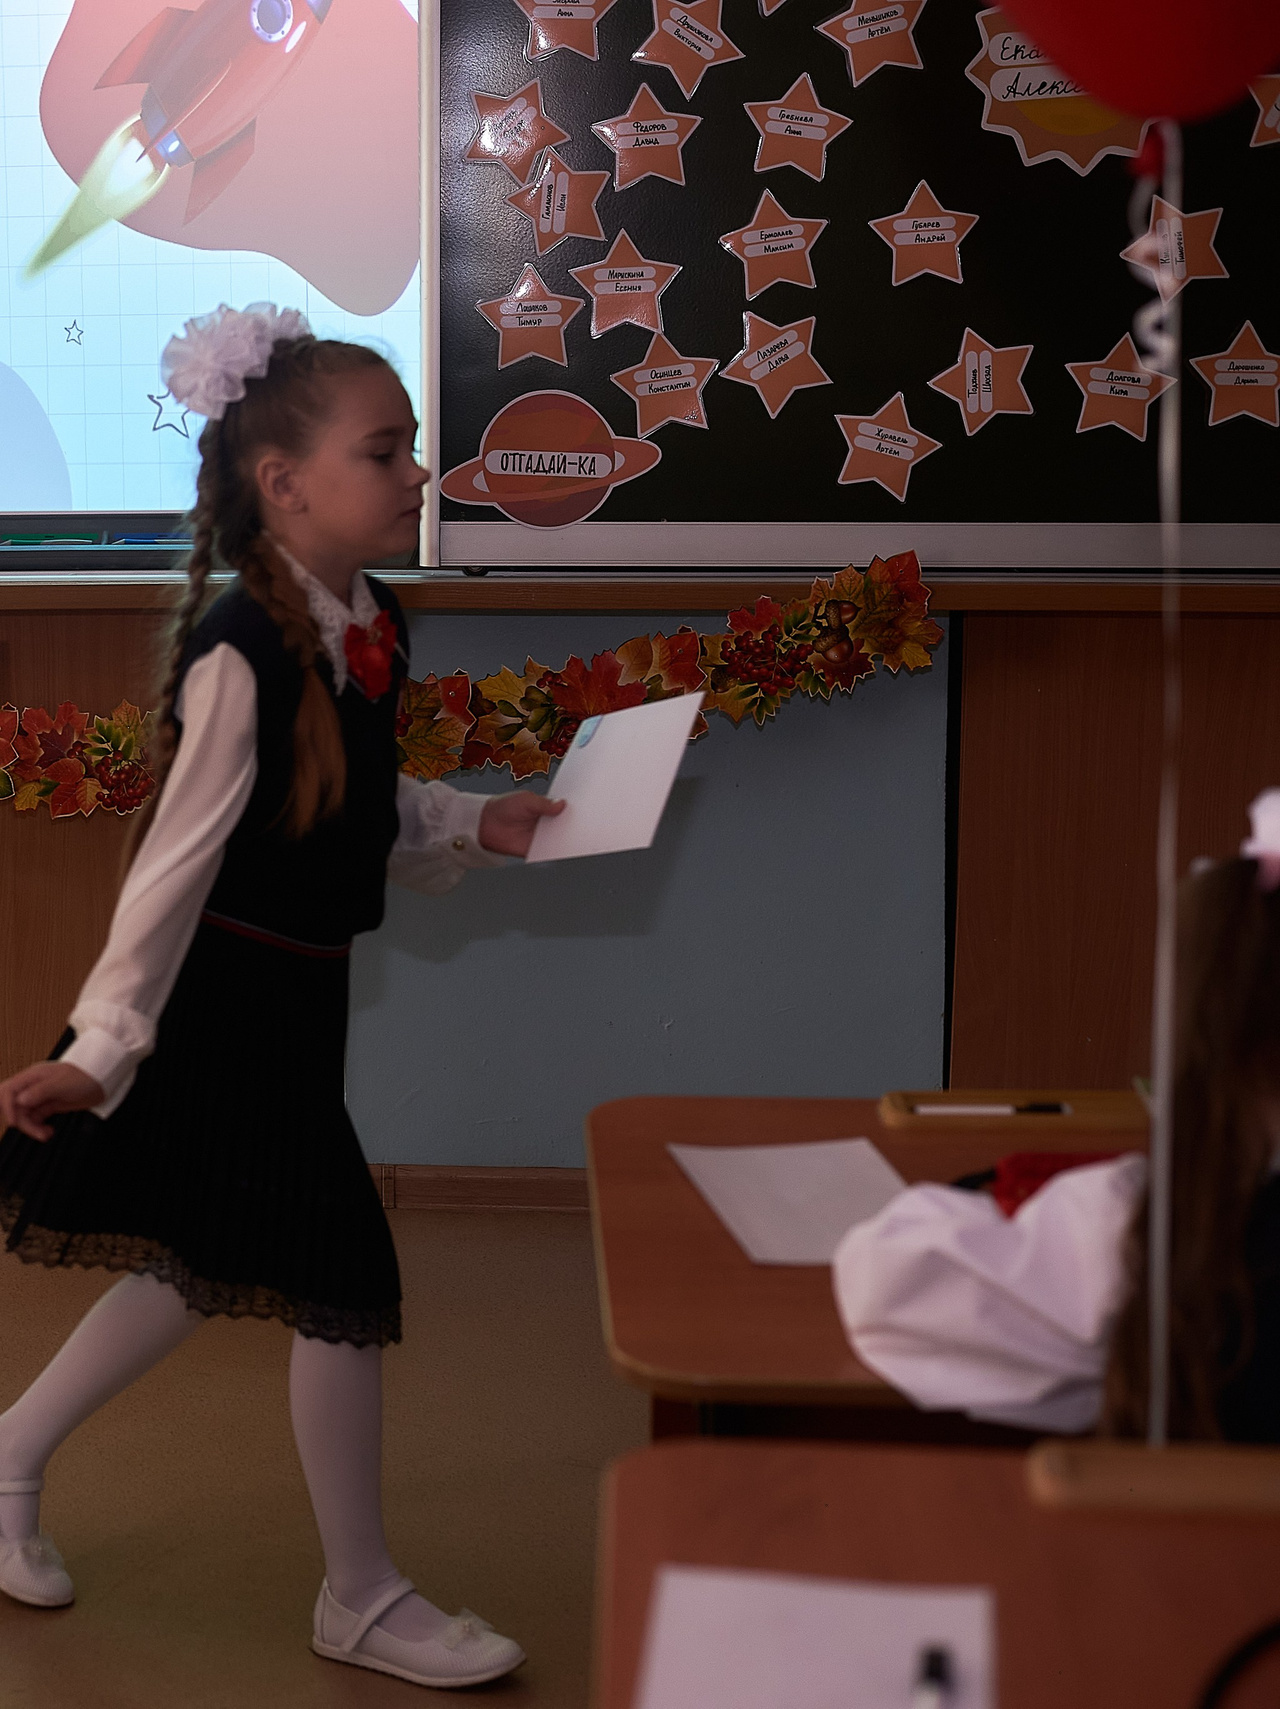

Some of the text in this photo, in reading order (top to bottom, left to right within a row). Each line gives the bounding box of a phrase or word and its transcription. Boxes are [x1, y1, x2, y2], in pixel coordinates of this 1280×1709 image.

[673, 28, 702, 53] Виктория
[778, 109, 814, 123] Гребнева
[784, 125, 802, 136] Анна
[632, 137, 660, 148] Давид
[911, 220, 941, 230] Губарев
[914, 233, 946, 244] Андрей
[763, 243, 794, 254] Максим
[515, 316, 543, 328] Тимур
[756, 338, 789, 362] Лазарева
[767, 353, 790, 373] Дарья
[650, 369, 683, 380] Осинцев
[1106, 371, 1141, 384] Долгова
[648, 381, 692, 394] Константин
[1109, 385, 1129, 396] Кира
[875, 427, 909, 444] Журавель
[875, 442, 900, 457] Артём
[500, 452, 597, 476] ОТГАДАЙ-КА
